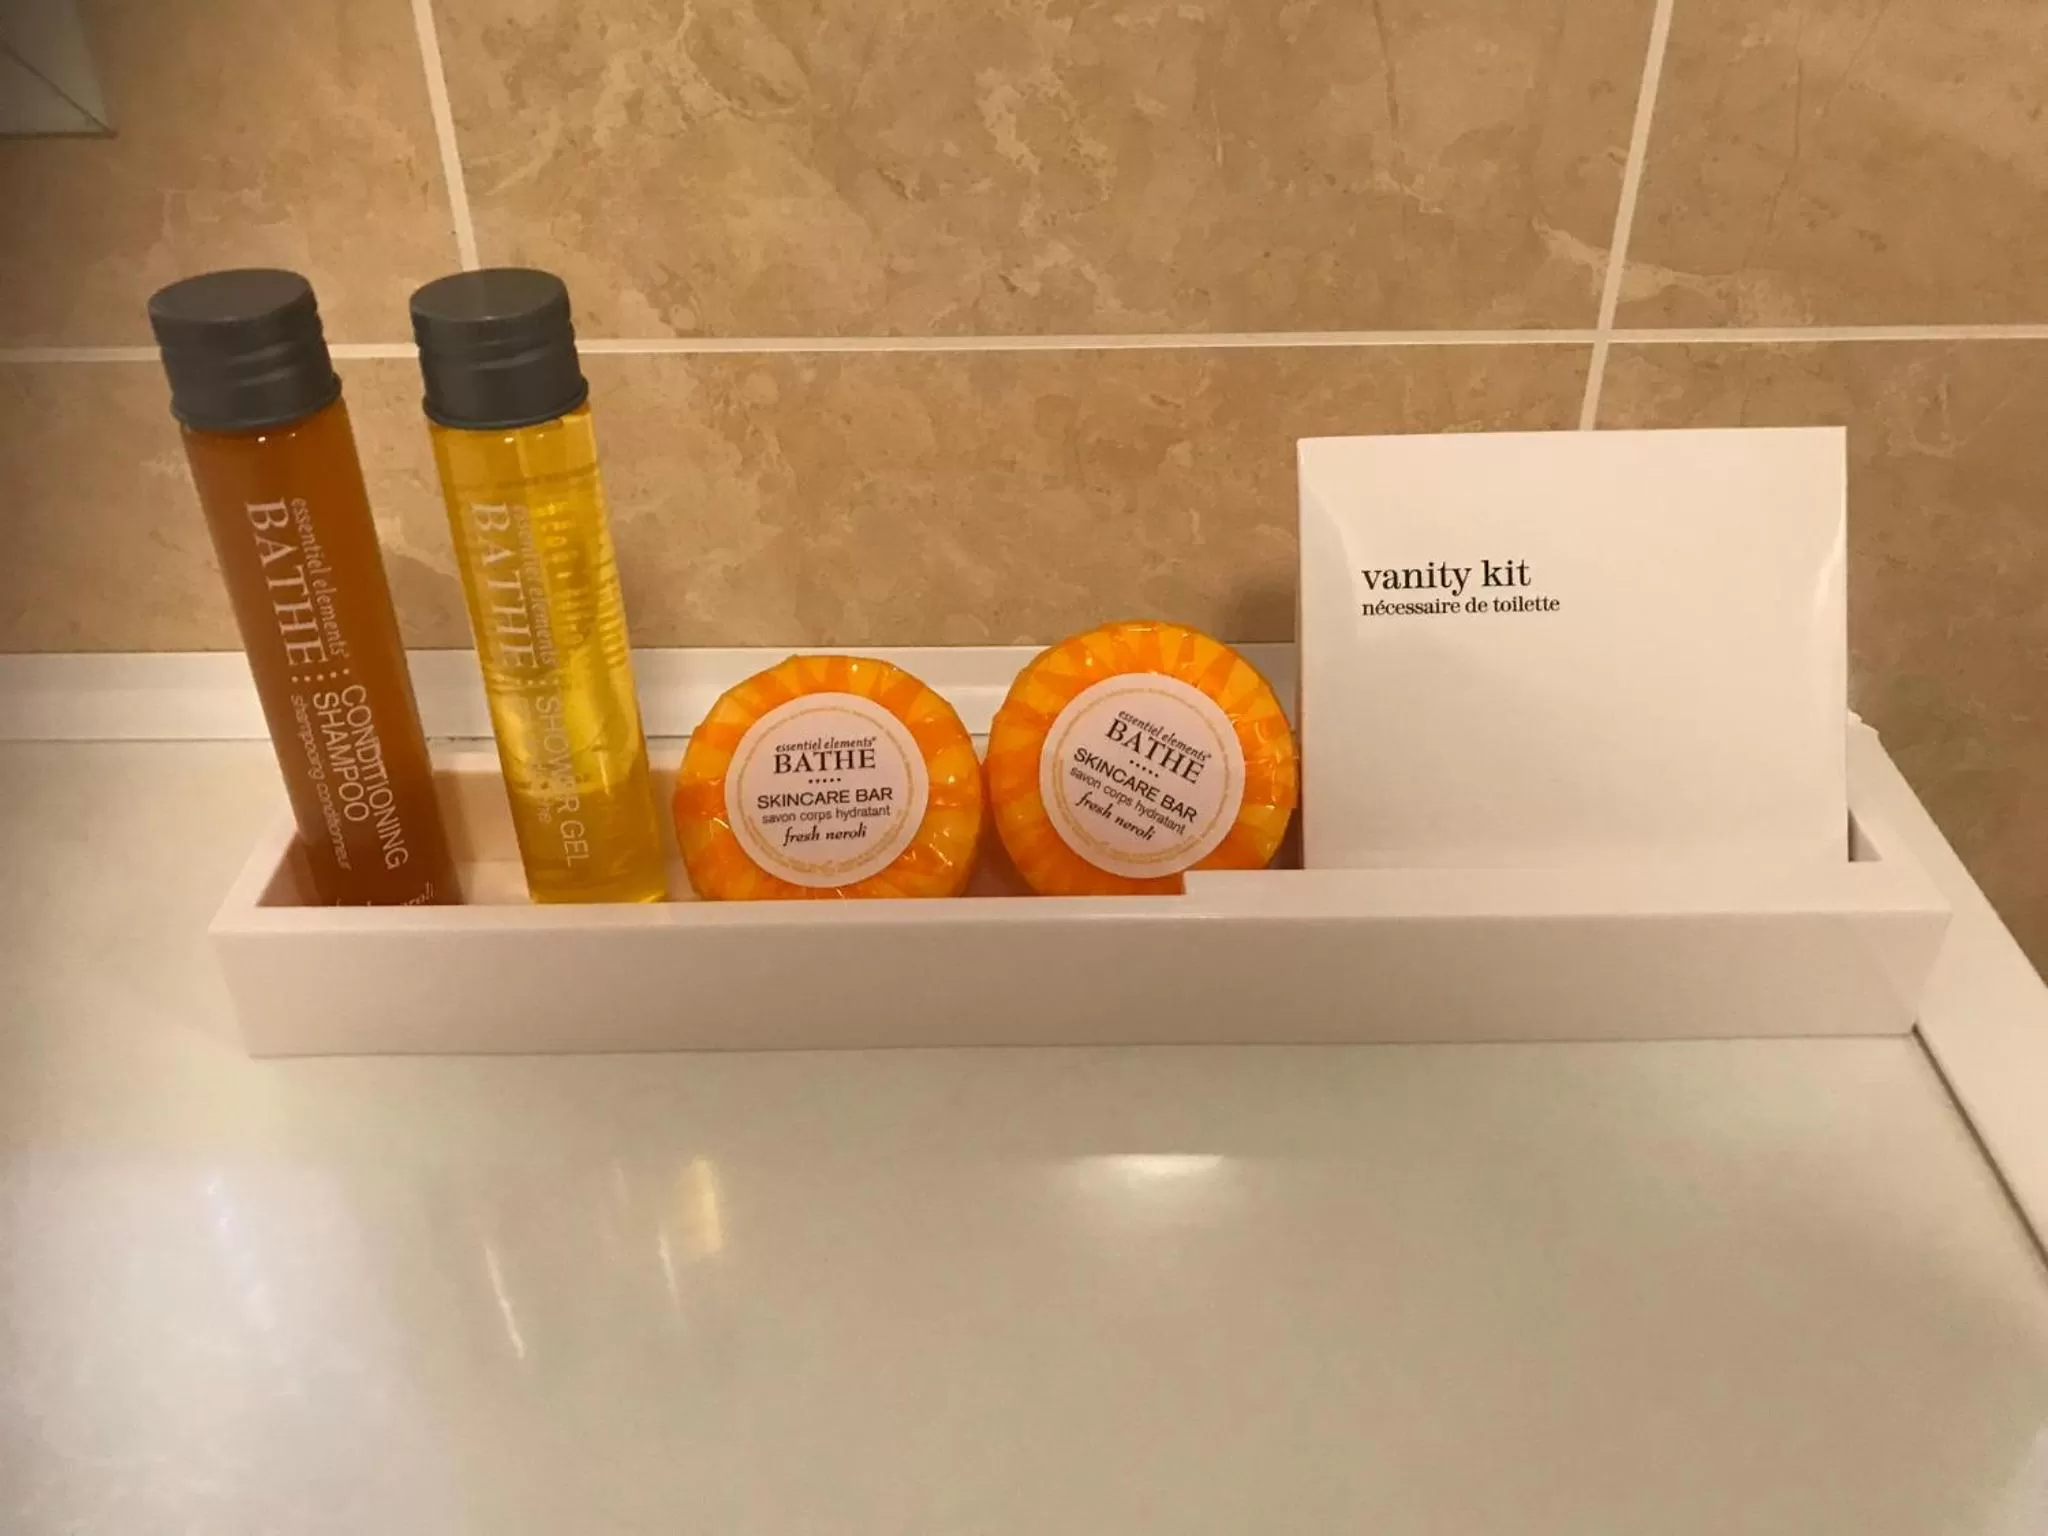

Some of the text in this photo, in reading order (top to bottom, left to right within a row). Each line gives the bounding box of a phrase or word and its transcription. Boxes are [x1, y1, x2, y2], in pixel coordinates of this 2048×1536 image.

[291, 497, 332, 574] essentiel
[244, 496, 329, 666] BATHE
[470, 501, 539, 669] BATHE
[1361, 559, 1532, 597] vanity kit
[1362, 595, 1560, 616] nécessaire de toilette
[776, 738, 821, 753] essentiel
[1118, 710, 1164, 738] essentiel
[312, 691, 370, 822] SHAMPOO
[773, 748, 876, 774] BATHE
[1104, 718, 1205, 784] BATHE
[341, 684, 409, 870] CONDITIONING
[756, 787, 893, 809] SKINCARE BAR
[1070, 766, 1187, 836] savon corps hydratant
[1073, 747, 1197, 823] SKINCARE BAR
[762, 805, 891, 824] savon corps hydratant
[783, 822, 868, 846] fresh neroli
[1075, 791, 1156, 841] fresh neroli
[560, 819, 589, 868] GEL
